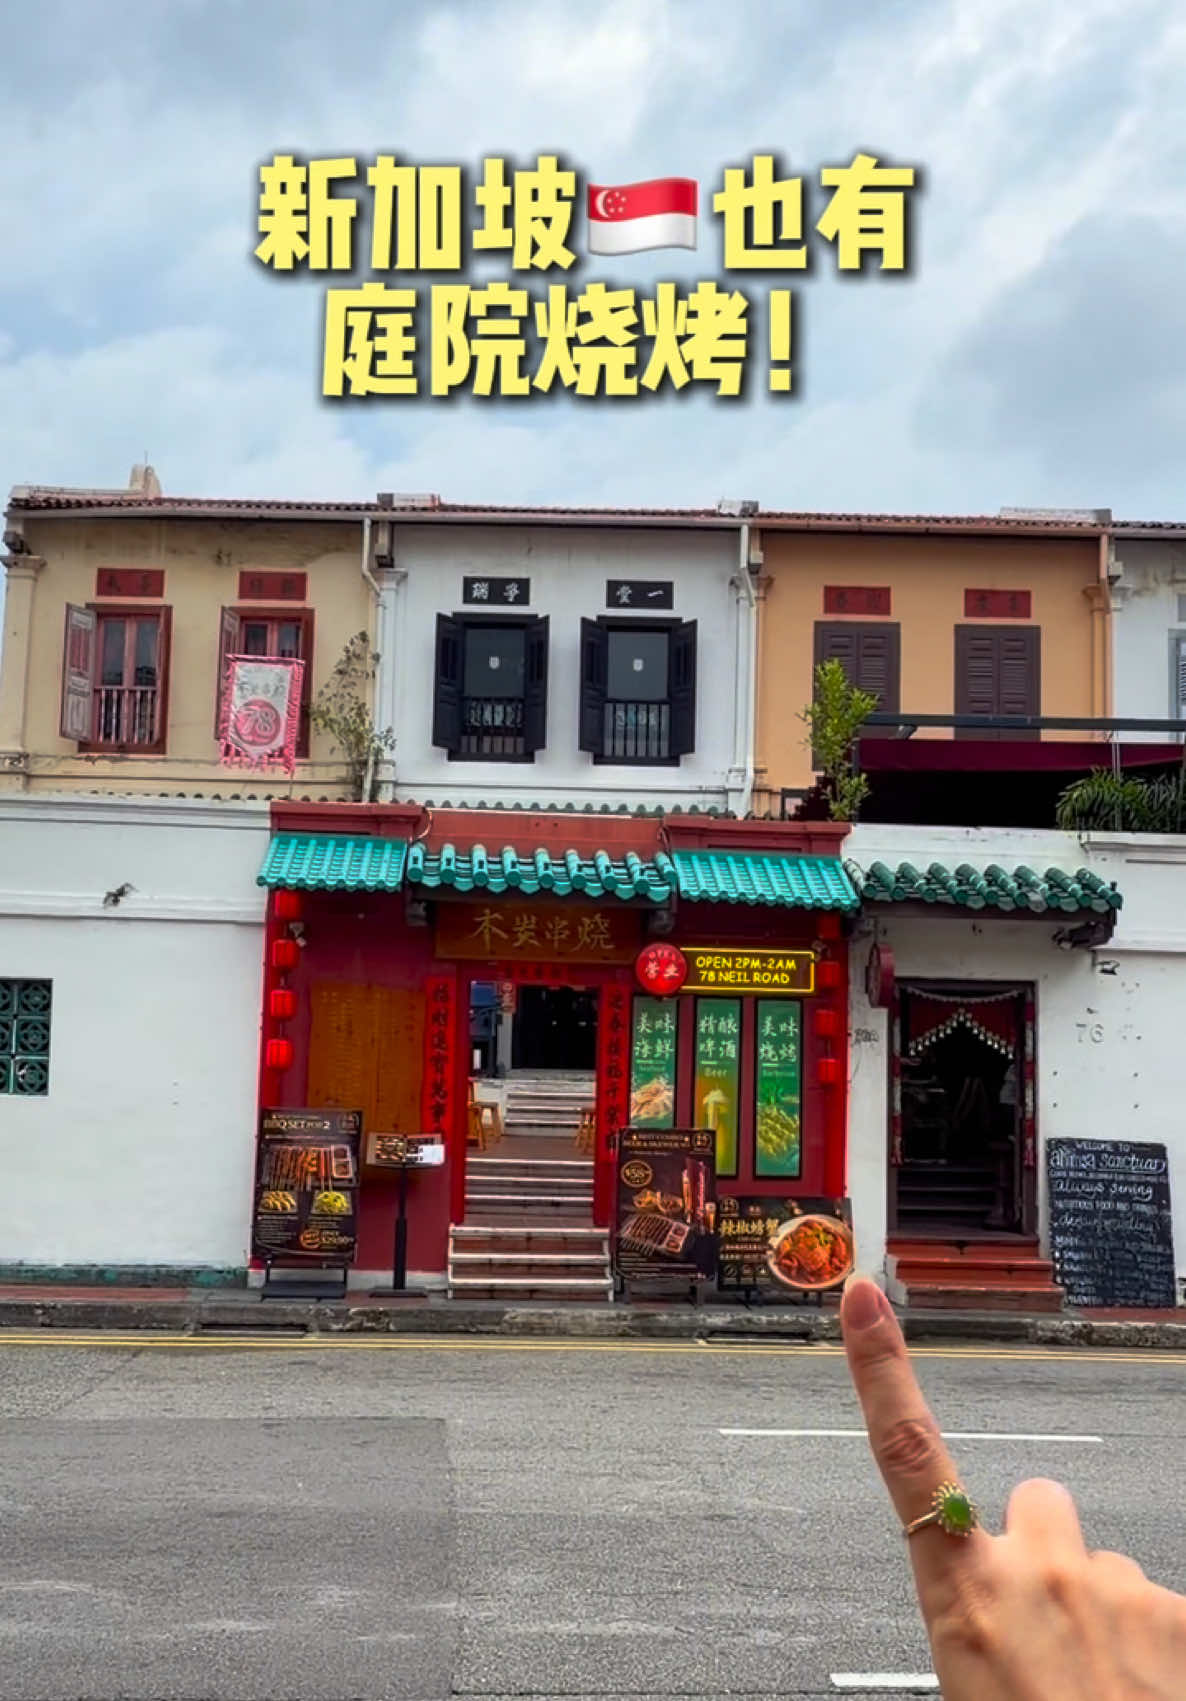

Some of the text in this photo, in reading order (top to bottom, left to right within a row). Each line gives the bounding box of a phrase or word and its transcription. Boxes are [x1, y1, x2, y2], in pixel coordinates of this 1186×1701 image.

[696, 956, 797, 971] OPEN 2PM-2AM
[699, 971, 790, 985] 78 NEIL ROAD
[636, 1011, 675, 1033] 美味
[699, 1012, 739, 1035] 精酿
[761, 1015, 799, 1037] 美味
[699, 1037, 737, 1059] 啤酒
[703, 1067, 728, 1078] Beer
[323, 1120, 331, 1130] 2
